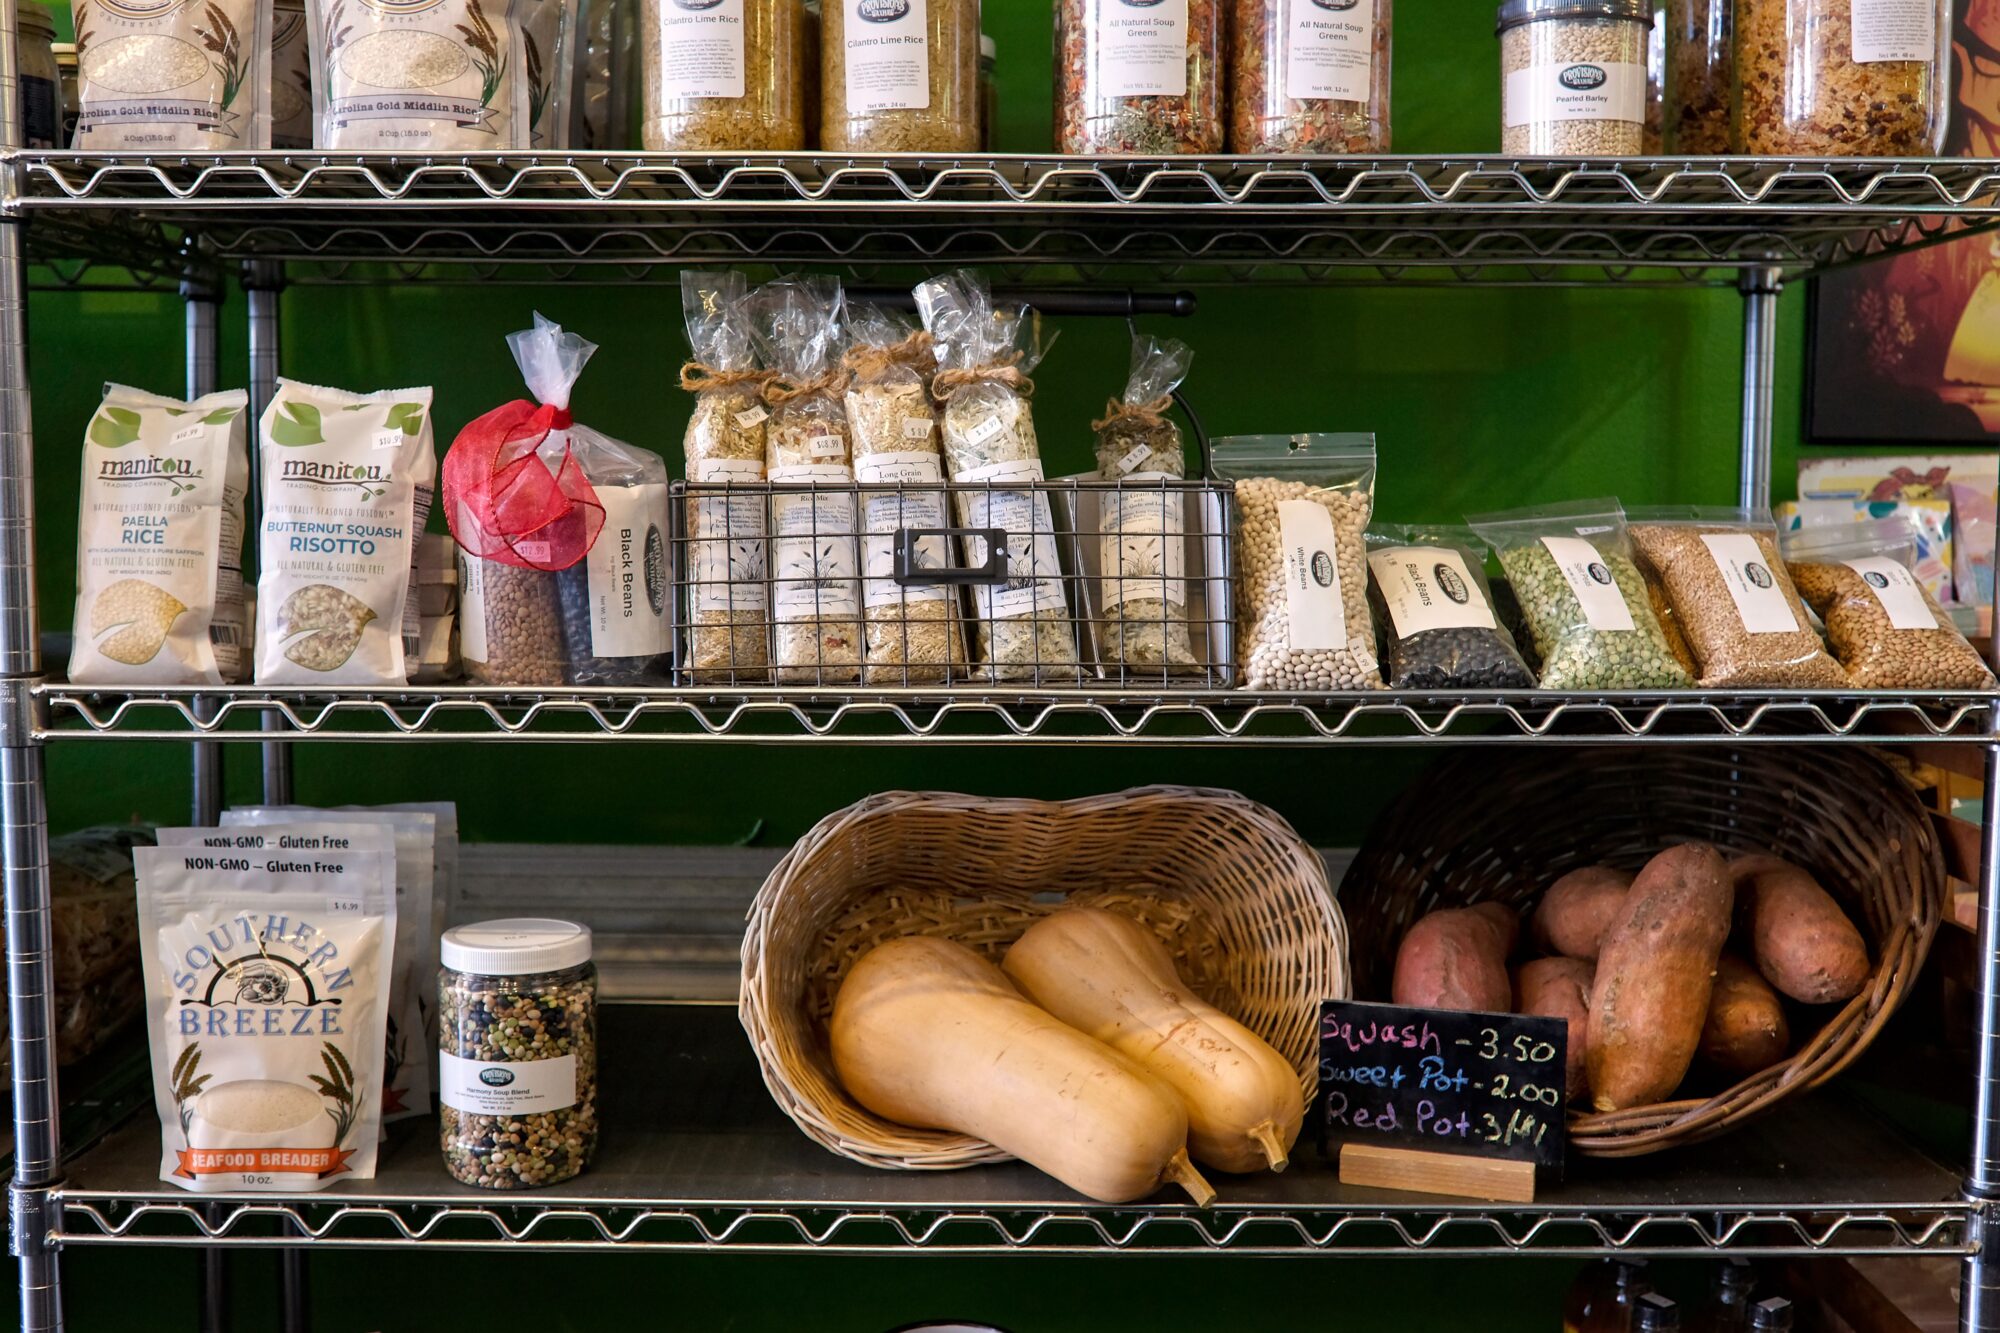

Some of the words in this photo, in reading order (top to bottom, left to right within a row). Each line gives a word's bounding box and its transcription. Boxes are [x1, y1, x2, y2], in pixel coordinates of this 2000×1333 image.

[663, 16, 693, 26] Cilantro
[695, 15, 717, 24] Lime
[719, 15, 739, 24] Rice
[1109, 19, 1120, 28] All
[1121, 19, 1151, 28] Natural
[1153, 18, 1175, 28] Soup
[1312, 22, 1343, 30] Natural
[1344, 23, 1364, 33] Soup
[1128, 29, 1158, 37] Greens
[1318, 32, 1348, 41] Greens
[847, 36, 878, 49] Cilantro
[880, 36, 902, 45] Lime
[904, 36, 924, 44] Rice
[376, 101, 400, 112] Gold
[403, 101, 449, 112] Middlin
[1556, 96, 1584, 104] Pearled
[1586, 95, 1608, 104] Barley
[120, 105, 144, 116] Gold
[148, 105, 190, 117] Middlin
[193, 108, 219, 119] Rice
[100, 455, 192, 476] manitou
[282, 460, 381, 480] manitou
[103, 481, 132, 489] TRADING
[316, 507, 352, 517] SEASONED
[122, 516, 168, 527] PAELLA
[122, 530, 164, 544] RICE
[267, 521, 344, 534] BUTTERNUT
[346, 524, 402, 539] SQUASH
[290, 536, 375, 556] RISOTTO
[620, 528, 634, 568] Black
[104, 558, 134, 566] NATURAL
[146, 558, 174, 568] GLUTEN
[178, 559, 195, 568] FREE
[290, 560, 324, 572] NATURAL
[336, 562, 366, 574] GLUTEN
[368, 564, 385, 575] FREE
[651, 532, 666, 609] PROVISIONS
[1300, 568, 1308, 590] Beans
[1406, 563, 1422, 582] Black
[1416, 582, 1432, 606] Beans
[622, 573, 633, 618] Beans
[280, 835, 320, 848] Gluten
[322, 836, 349, 848] Free
[185, 858, 250, 872] NON-GMO
[266, 860, 312, 873] Gluten
[315, 862, 344, 874] Free
[173, 914, 355, 996] SOUTHERN
[179, 1008, 344, 1038] BREEZE
[1320, 1012, 1441, 1056] Squash
[1479, 1028, 1556, 1063] 3.50
[1319, 1058, 1407, 1090] Sweet
[1418, 1055, 1470, 1092] Pot
[1491, 1074, 1559, 1107] 2.00
[466, 1088, 492, 1096] Harmony
[1328, 1091, 1402, 1132] Red
[1416, 1100, 1470, 1138] Pot
[192, 1153, 255, 1168] SEAFOOD
[260, 1152, 330, 1167] BREADER
[242, 1174, 254, 1184] 10
[257, 1176, 273, 1185] oz.
